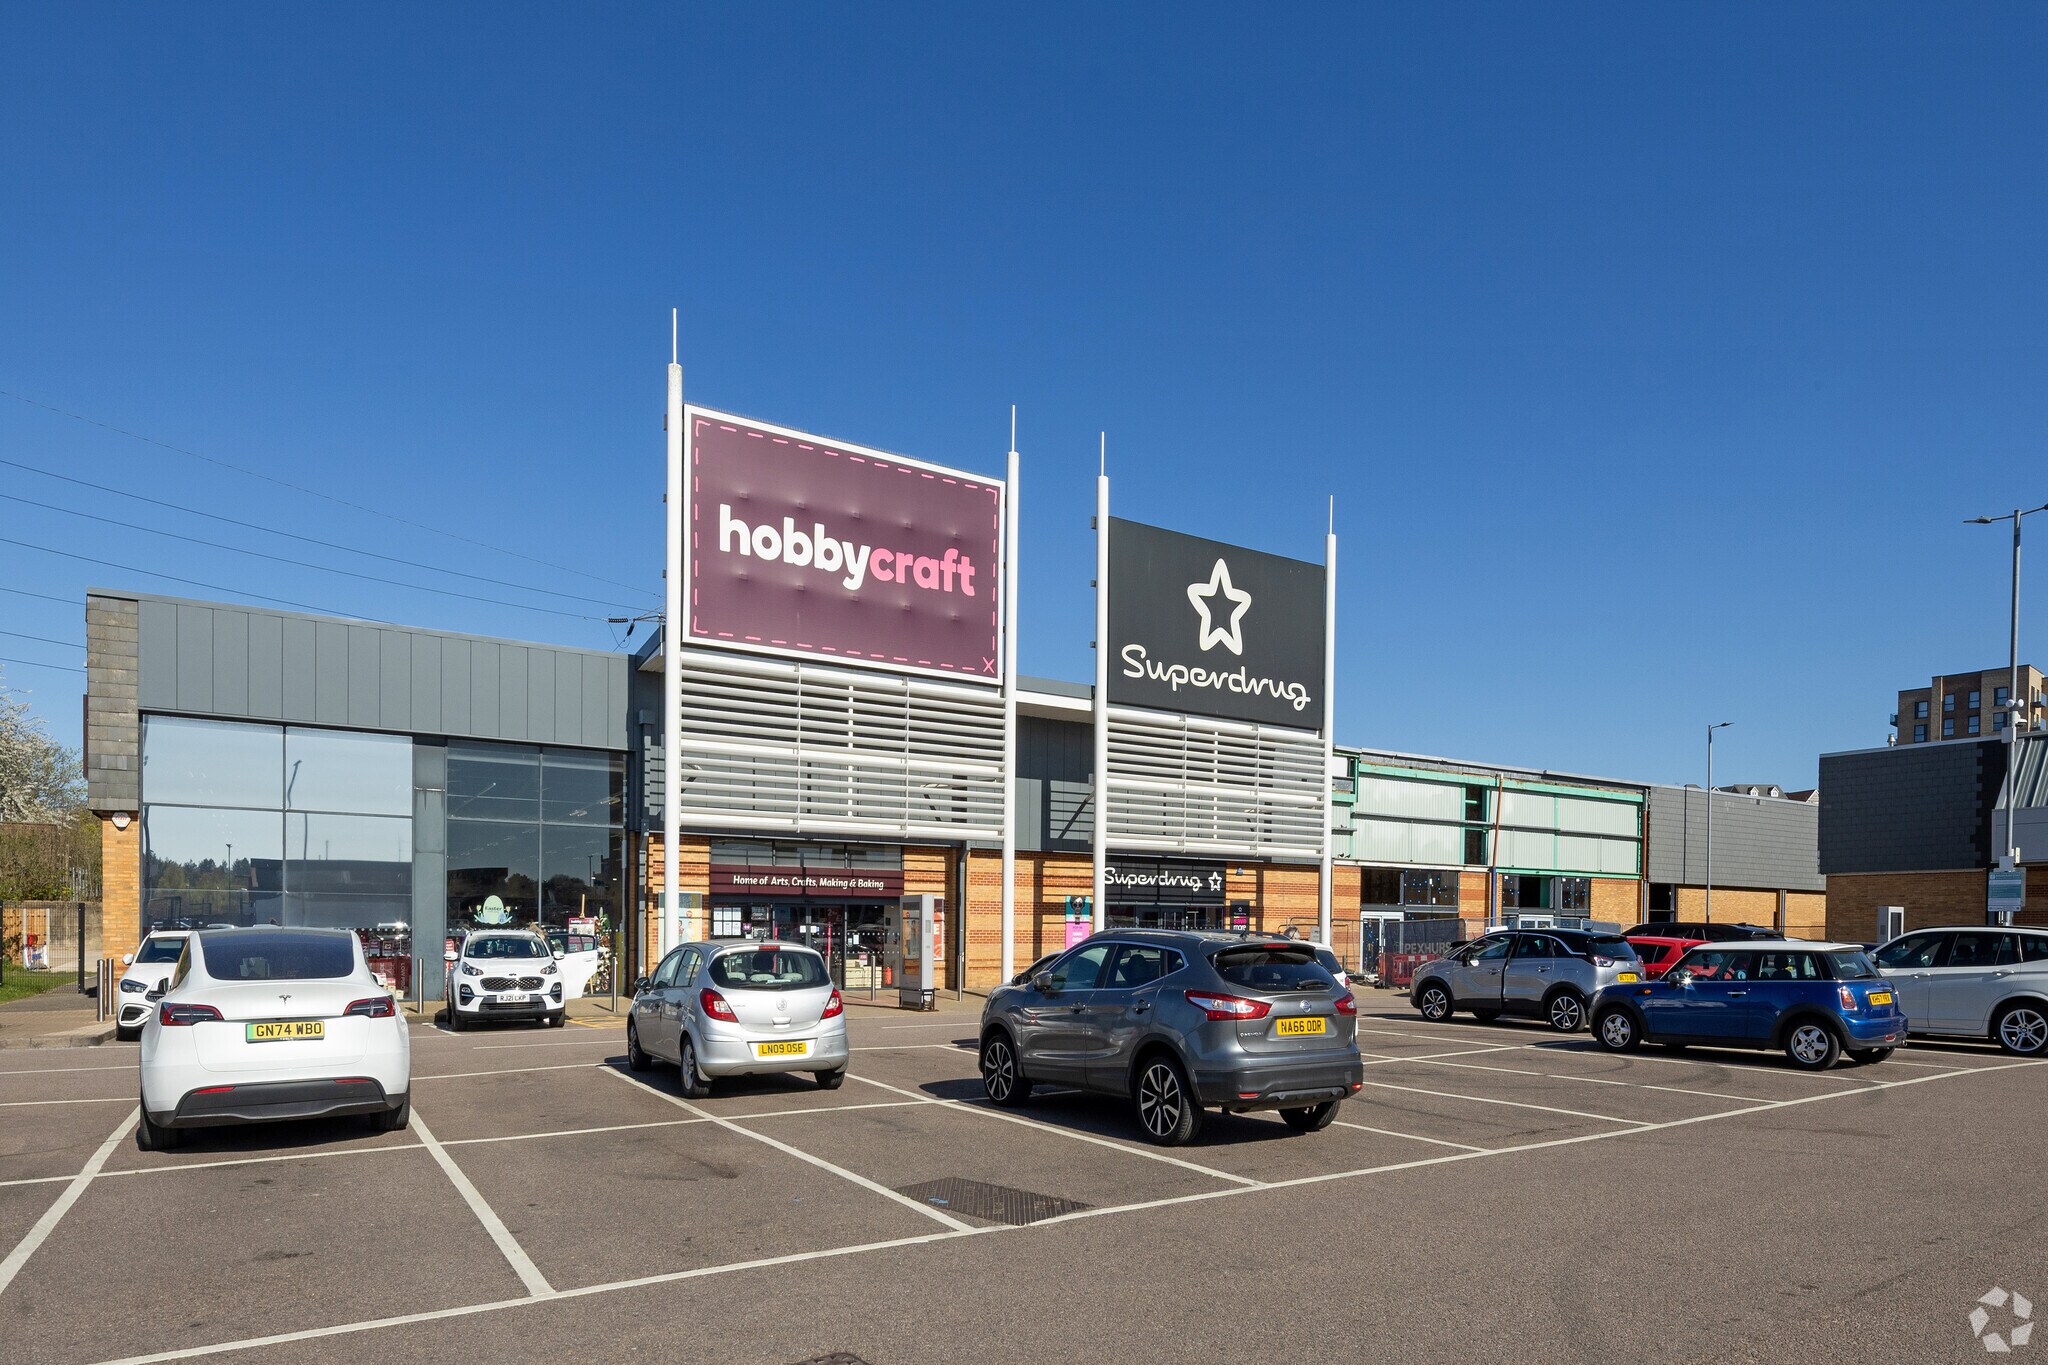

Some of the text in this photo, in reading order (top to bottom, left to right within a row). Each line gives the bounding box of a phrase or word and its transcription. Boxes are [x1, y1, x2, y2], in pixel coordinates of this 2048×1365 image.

[719, 503, 976, 597] hobbycraft
[1121, 644, 1311, 711] Superdrug
[733, 875, 884, 890] Home of Arts, Crafts, Making & Baking
[1104, 867, 1202, 892] Superdrug
[1404, 942, 1452, 954] PEXHURS
[256, 1024, 292, 1037] GN74
[1281, 1020, 1322, 1033] NA66 ODR
[761, 1043, 804, 1054] LN09 OSE
